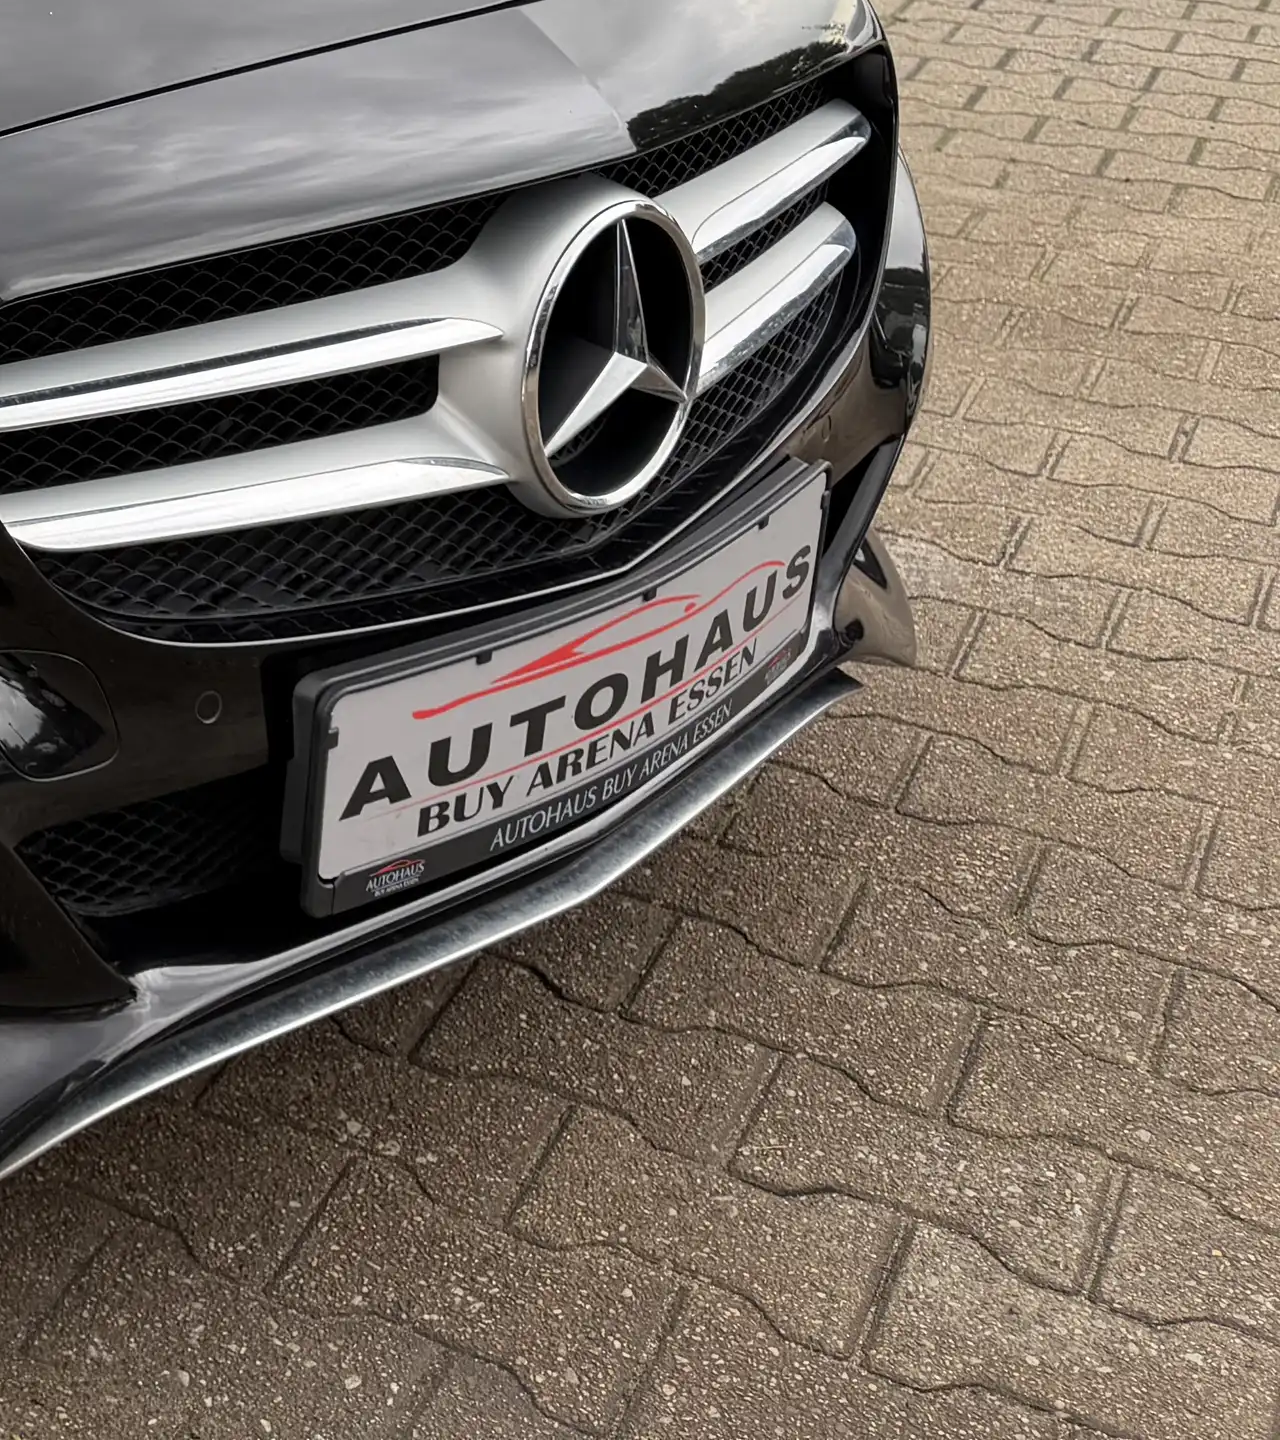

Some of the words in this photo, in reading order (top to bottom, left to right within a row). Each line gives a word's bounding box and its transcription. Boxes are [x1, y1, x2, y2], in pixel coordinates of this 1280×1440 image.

[339, 544, 812, 822] AUTOHAUS
[417, 775, 514, 838] BUY
[526, 711, 654, 797] ARENA
[668, 637, 757, 725] ESSEN
[490, 786, 597, 851] AUTOHAUS
[602, 763, 638, 801] BUY
[640, 735, 689, 778] ARENA
[692, 698, 733, 744] ESSEN
